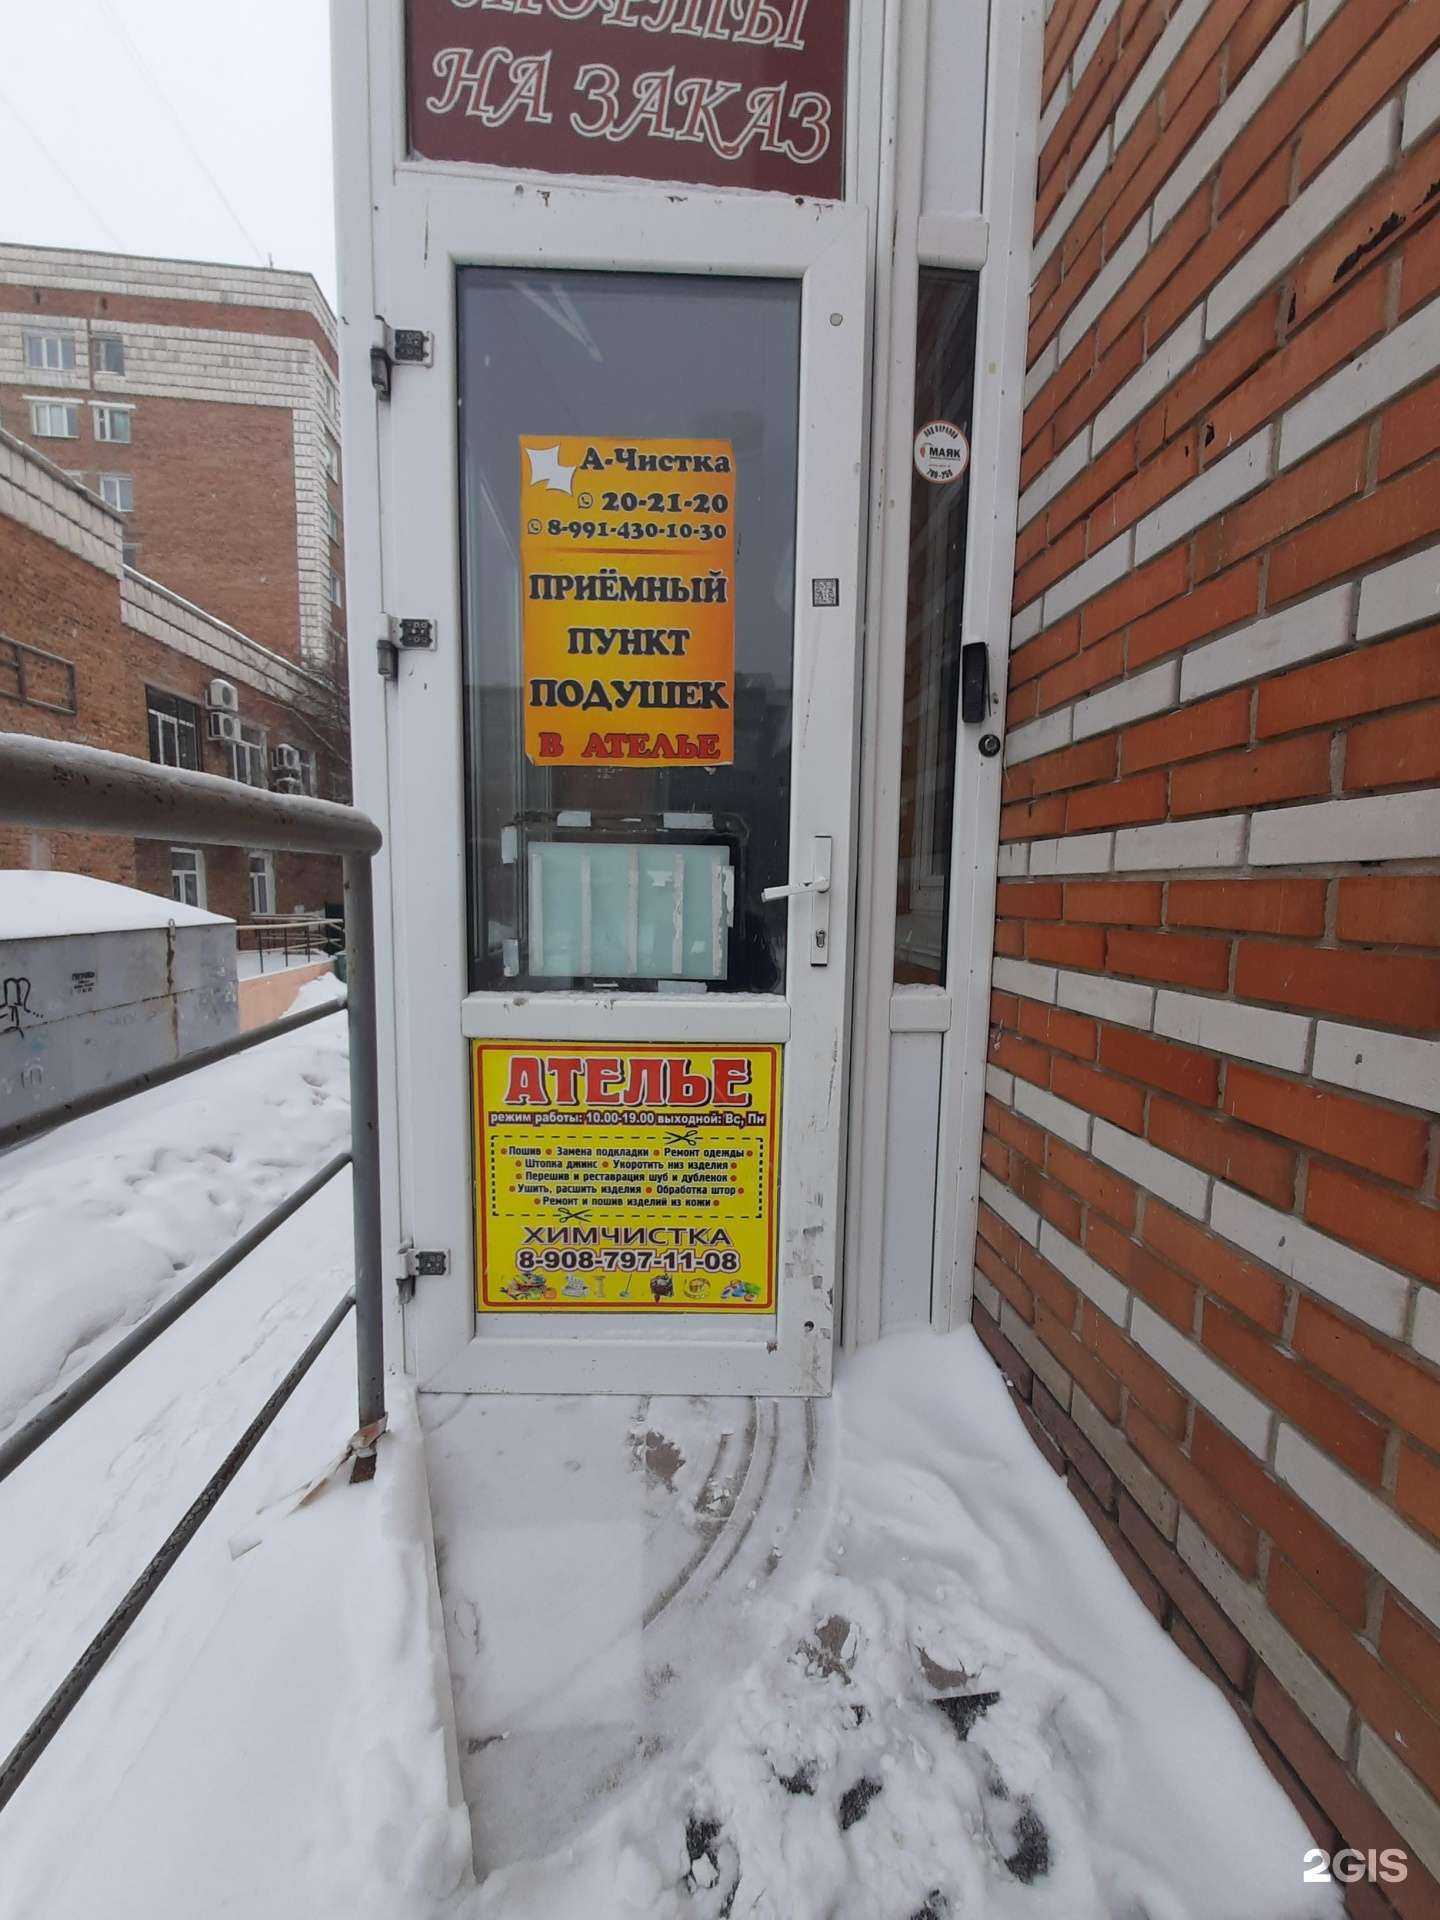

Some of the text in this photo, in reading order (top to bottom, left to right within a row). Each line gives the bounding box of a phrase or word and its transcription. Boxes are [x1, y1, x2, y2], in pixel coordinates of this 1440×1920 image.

[427, 47, 832, 164] НА ЗАКАЗ
[579, 447, 731, 473] А-Чистка
[929, 447, 961, 458] МАЯК
[601, 492, 729, 514] 20-21-20
[547, 519, 727, 540] 8-991-430-10-30
[529, 568, 728, 603] ПРИЁМНЫЙ
[567, 628, 691, 656] ПУНКТ
[529, 679, 730, 711] ПОДУШЕК
[538, 732, 721, 760] В АТЕЛЬЕ
[504, 1055, 752, 1107] АТЕЛЬЕ
[490, 1110, 765, 1128] режим работы: 10.00-19.00 выходной: Вс, Пн
[508, 1146, 745, 1159] Пошив Замена подкладки Ремонт одежды
[525, 1159, 729, 1171] Штопка джинс Укоротить низ изделия
[526, 1172, 570, 1181] Перешив
[573, 1173, 580, 1181] и
[583, 1173, 646, 1183] реставрация
[649, 1173, 669, 1183] шуб
[681, 1173, 728, 1183] дубленок
[556, 1185, 598, 1195] расшить
[601, 1186, 642, 1195] изделия
[657, 1185, 708, 1196] Обработка
[711, 1187, 737, 1197] штор
[543, 1197, 712, 1208] Ремонт и пошив изделий из кожи
[523, 1226, 732, 1247] ХИМЧИСТКА
[515, 1249, 741, 1273] 8-908-797-11-08
